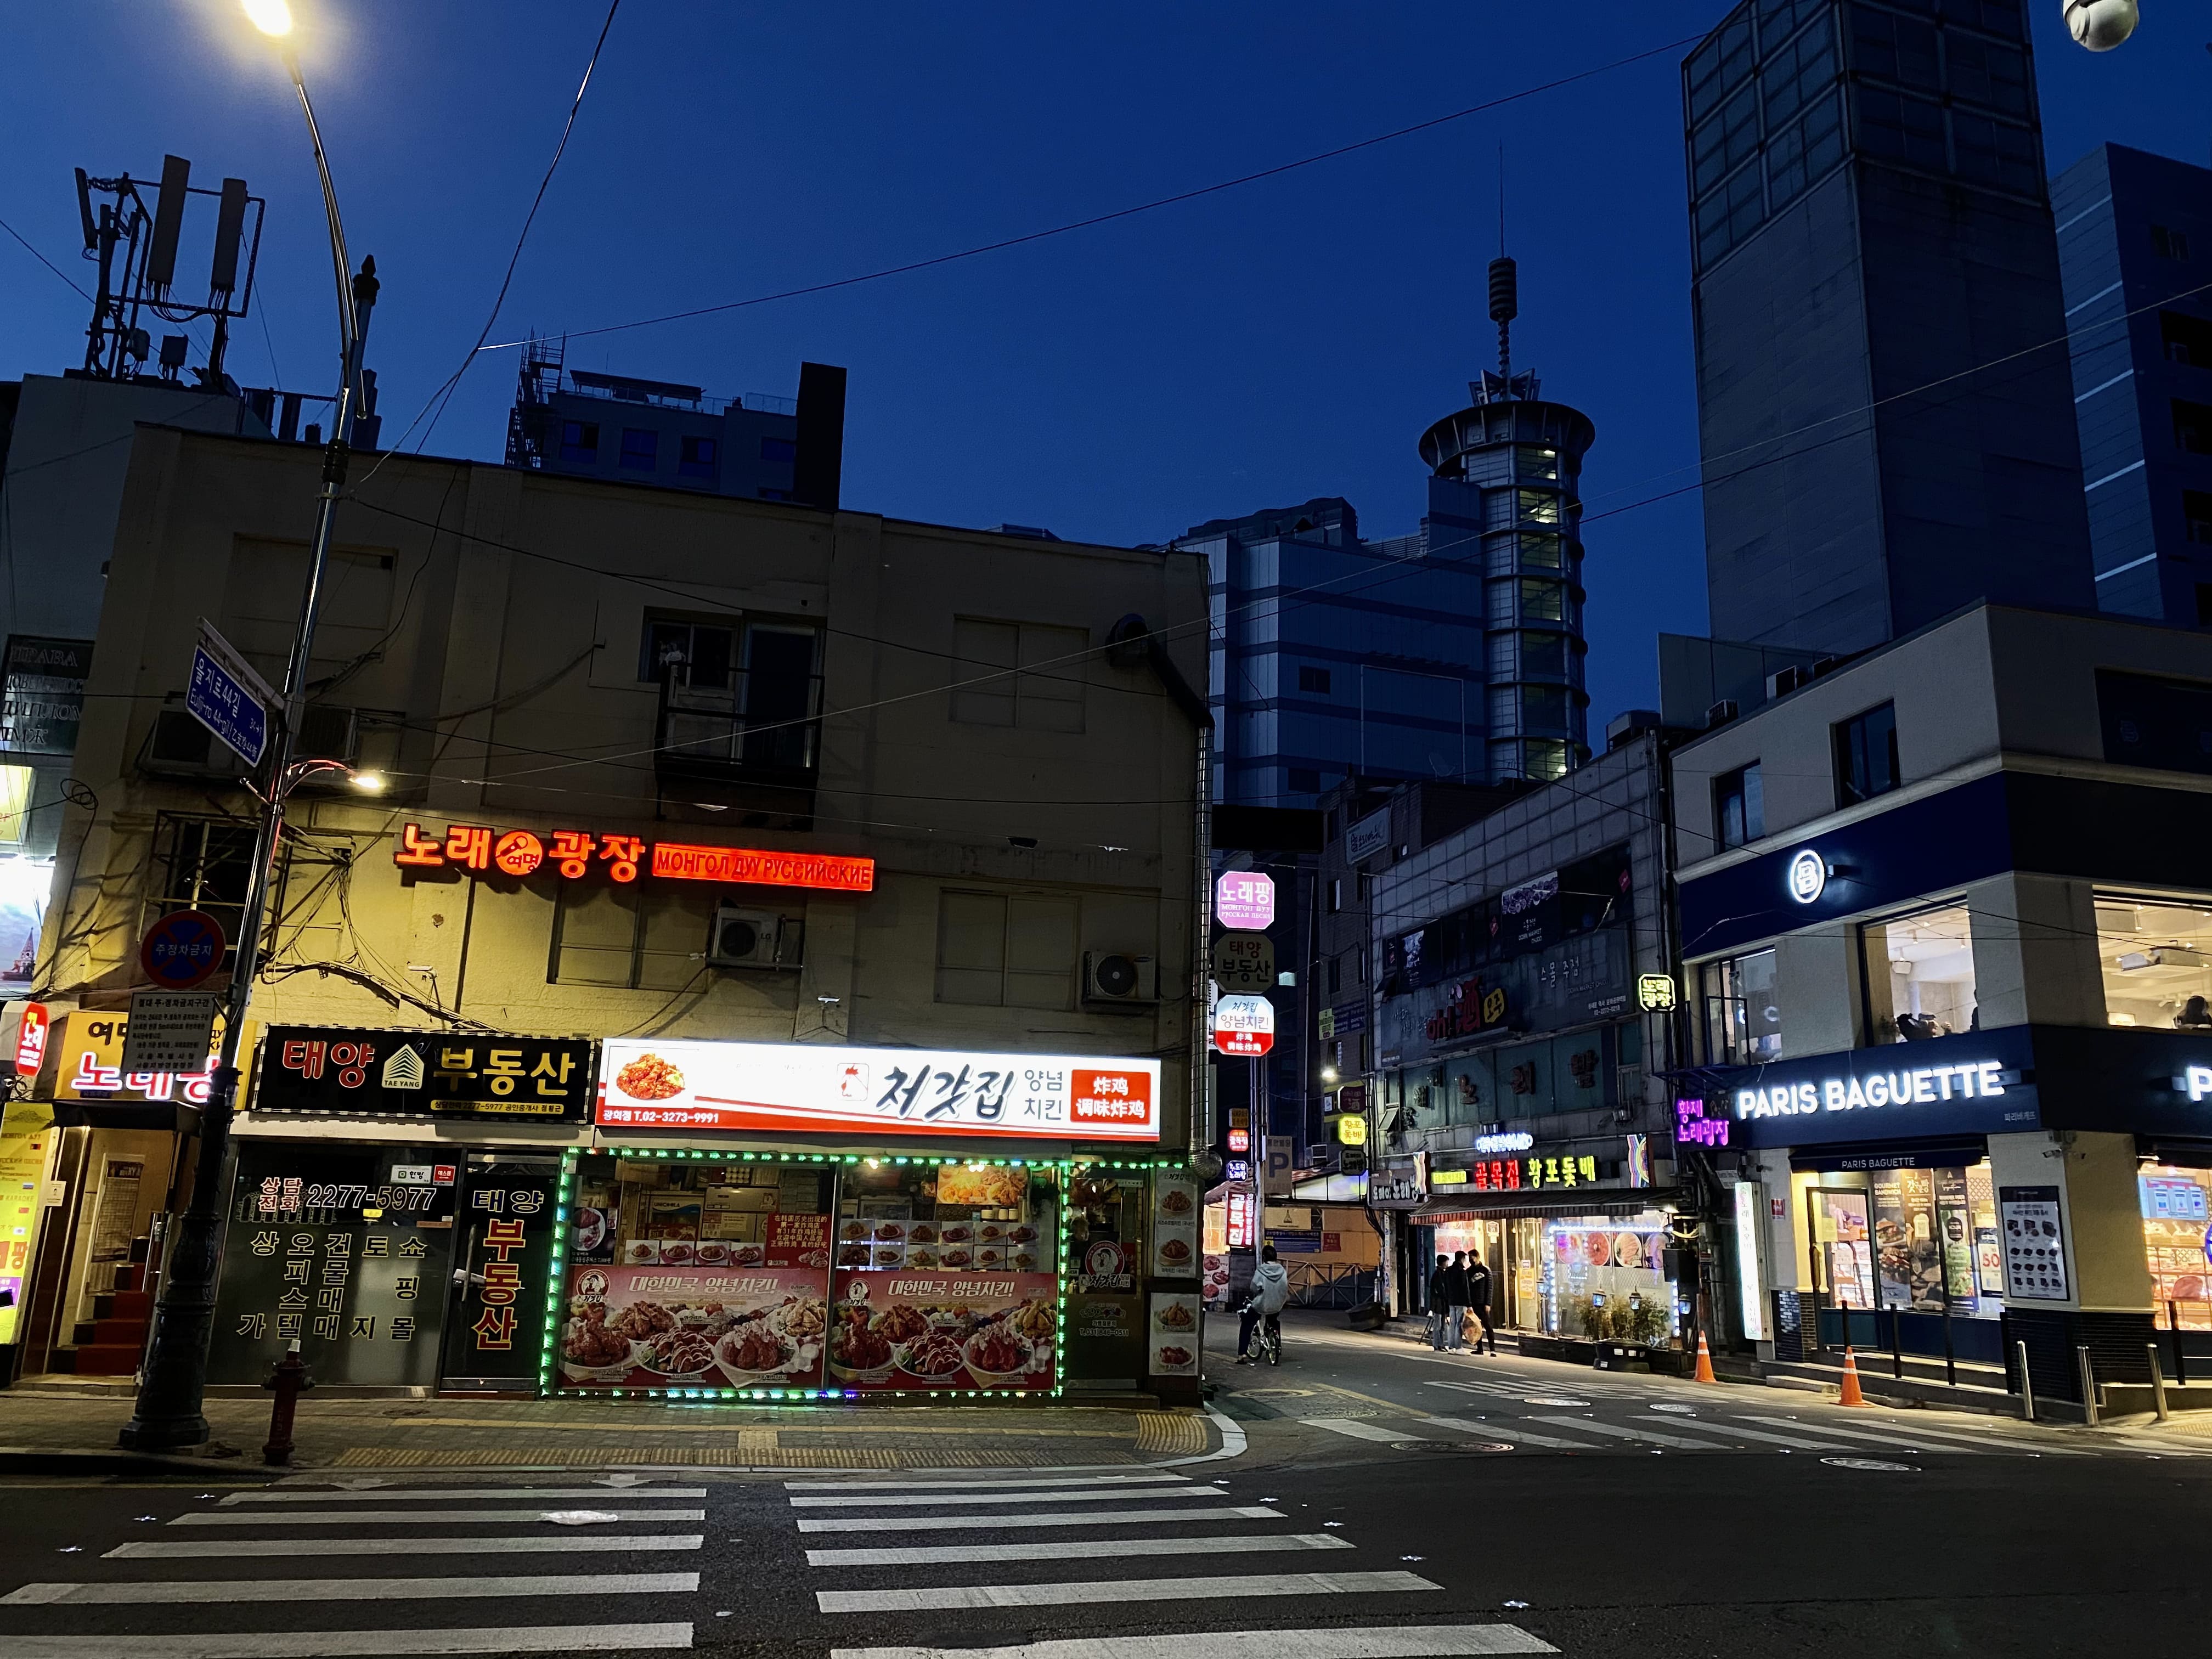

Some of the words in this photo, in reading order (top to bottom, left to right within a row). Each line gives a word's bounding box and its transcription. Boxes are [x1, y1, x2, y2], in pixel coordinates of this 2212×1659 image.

[195, 658, 241, 718] 을지로44길
[394, 824, 492, 869] 노래
[507, 852, 540, 872] 여명
[549, 831, 646, 883] 광장
[656, 850, 730, 874] МОНГОЛ
[731, 855, 762, 879] ДУУ
[763, 859, 872, 885] РУССИЙСКИЕ
[155, 944, 212, 956] 주정차금지
[1229, 940, 1262, 958] 태양
[1220, 959, 1271, 983] 부동산
[1221, 1014, 1269, 1030] 양념치킨
[281, 1040, 376, 1089] 태양
[433, 1047, 575, 1096] 부동산
[384, 1080, 398, 1088] TAE
[399, 1080, 420, 1088] YANG
[876, 1063, 1015, 1120] 처갓집
[1024, 1069, 1063, 1092] 양념
[1093, 1076, 1130, 1096] 炸鸡
[1738, 1083, 1818, 1120] PARIS
[1825, 1061, 2006, 1111] BAGUETTE
[463, 1102, 503, 1111] 2277-5977
[505, 1104, 538, 1112] 공인중개사
[603, 1110, 632, 1122] 광희점
[633, 1110, 719, 1124] T.02-3273-9991
[1024, 1097, 1063, 1121] 치킨
[1076, 1098, 1146, 1119] 调味炸鸡
[1678, 1099, 1703, 1124] 황제
[1344, 1119, 1362, 1128] 황포
[1679, 1120, 1729, 1146] 노래광장
[1344, 1130, 1362, 1139] 돛배
[1269, 1152, 1289, 1178] P
[1476, 1160, 1520, 1190] 골목집
[1528, 1155, 1596, 1189] 황포돛배
[1841, 1160, 1866, 1169] PARIS
[1869, 1157, 1915, 1169] BAGUETTE
[260, 1176, 303, 1195] 상담
[409, 1171, 425, 1180] 한방
[258, 1194, 301, 1213] 전화
[306, 1183, 437, 1211] 2277-5977
[472, 1189, 544, 1214] 태양
[471, 1218, 526, 1350] 부동산
[629, 1276, 698, 1294] 대한민국
[704, 1277, 779, 1295] 양념치킨!
[888, 1279, 947, 1297] 대한민국
[951, 1280, 1015, 1297] 양념치킨!
[1091, 1273, 1121, 1288] 처갓집
